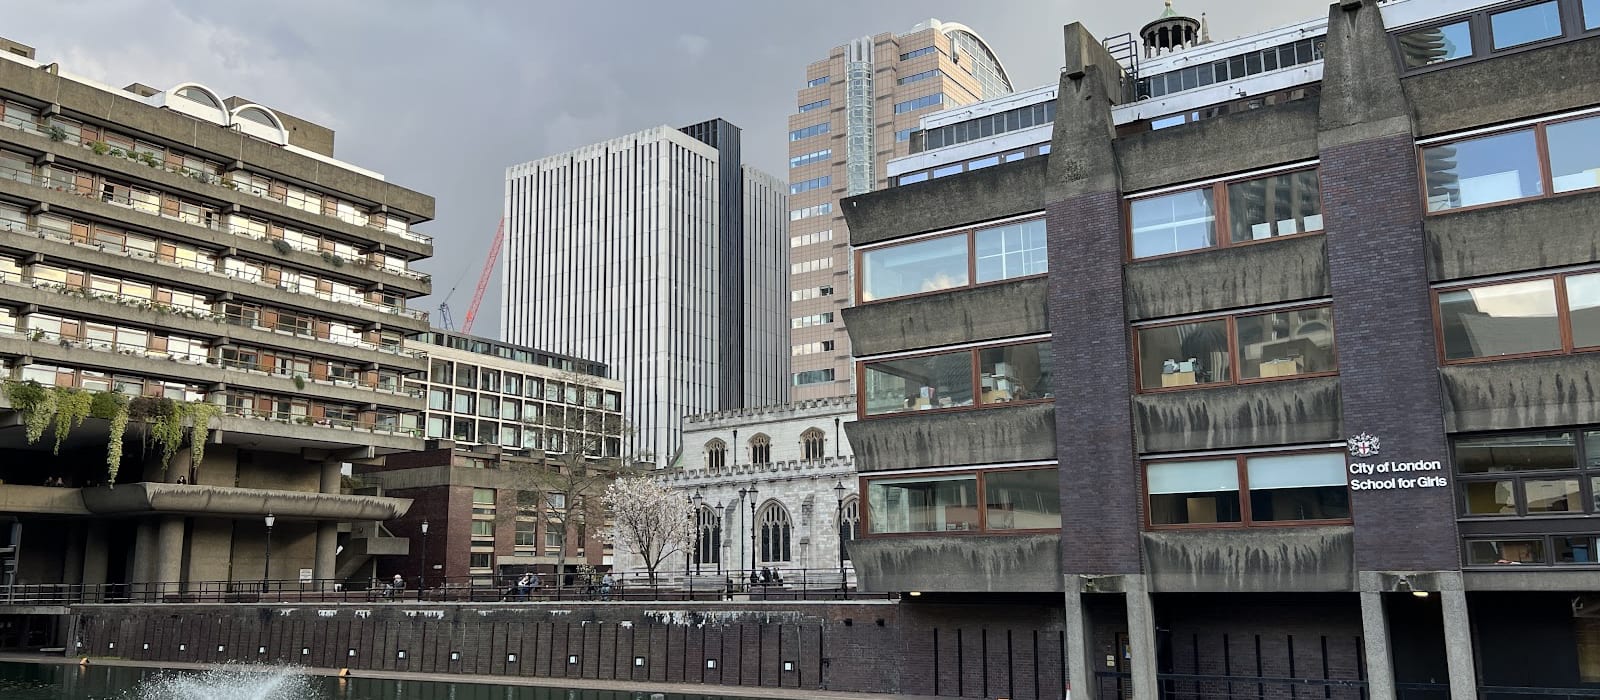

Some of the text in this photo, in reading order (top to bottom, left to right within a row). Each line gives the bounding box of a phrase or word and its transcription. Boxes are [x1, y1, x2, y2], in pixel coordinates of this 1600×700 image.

[1350, 460, 1441, 474] City of London
[1350, 476, 1448, 490] School for Girls
